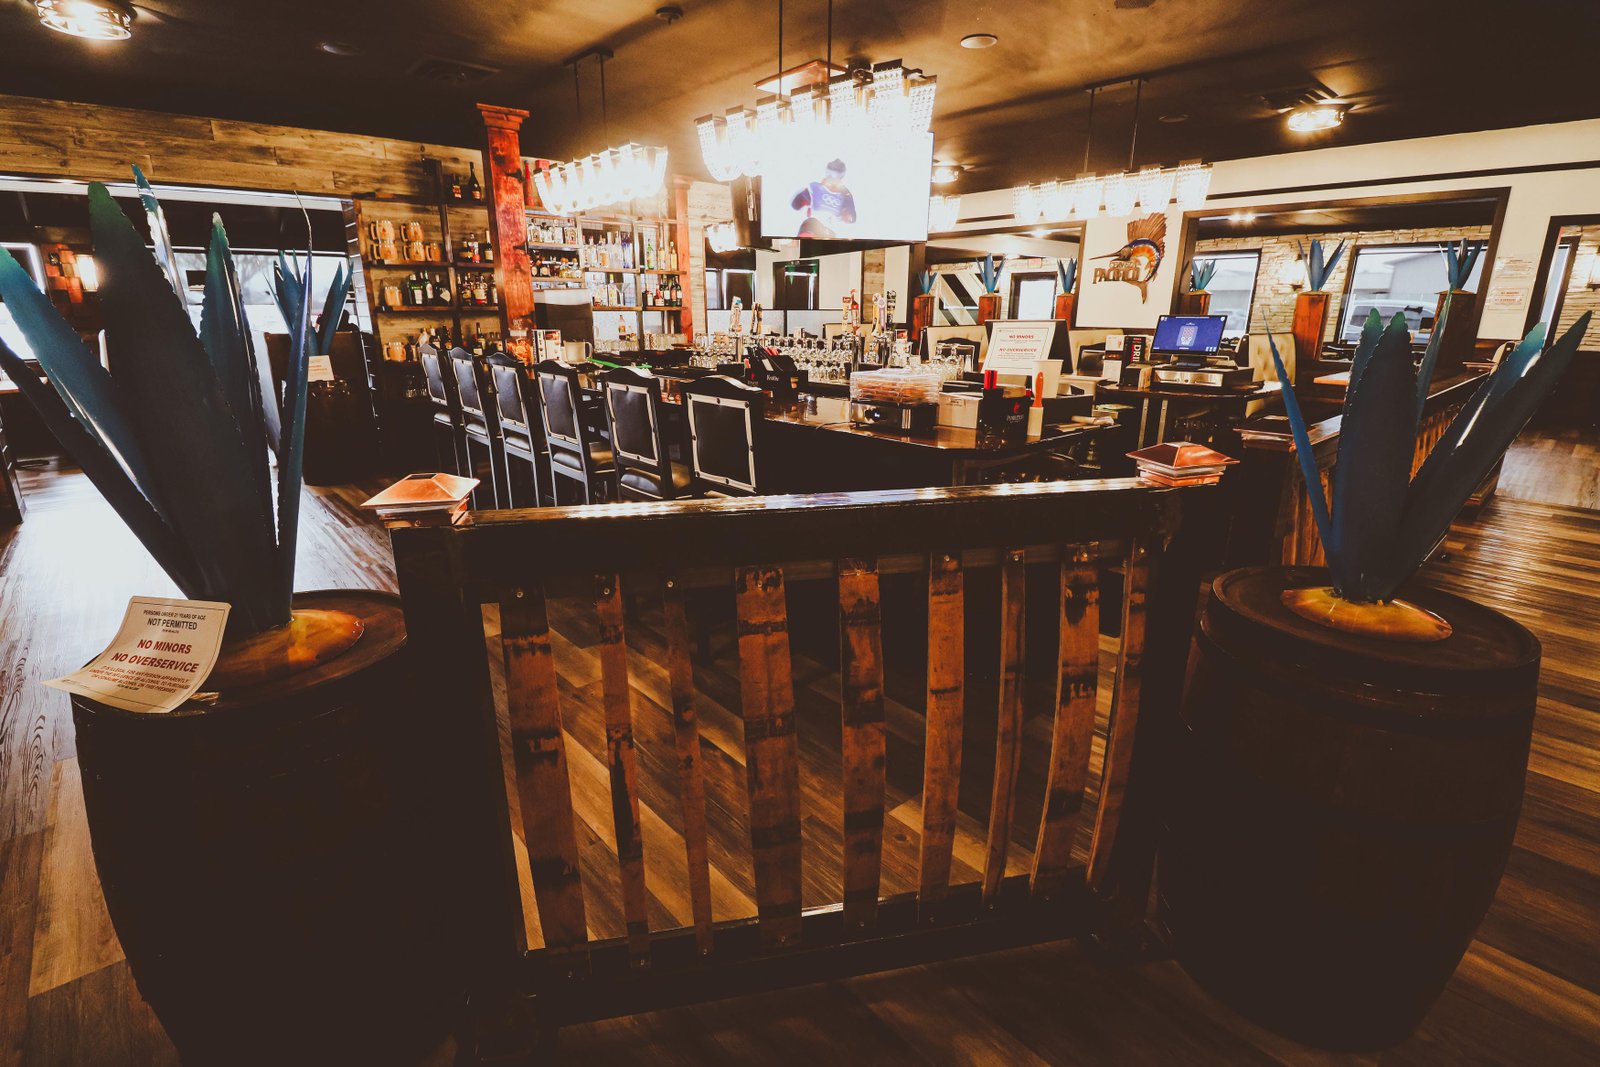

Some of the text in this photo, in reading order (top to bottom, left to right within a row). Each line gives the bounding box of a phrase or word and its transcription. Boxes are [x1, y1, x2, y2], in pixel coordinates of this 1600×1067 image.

[1093, 267, 1140, 284] PACIFICO
[147, 618, 198, 630] NOT PERMITTED
[137, 639, 192, 654] NO MINORS
[111, 652, 200, 673] NO OVERSERVICE
